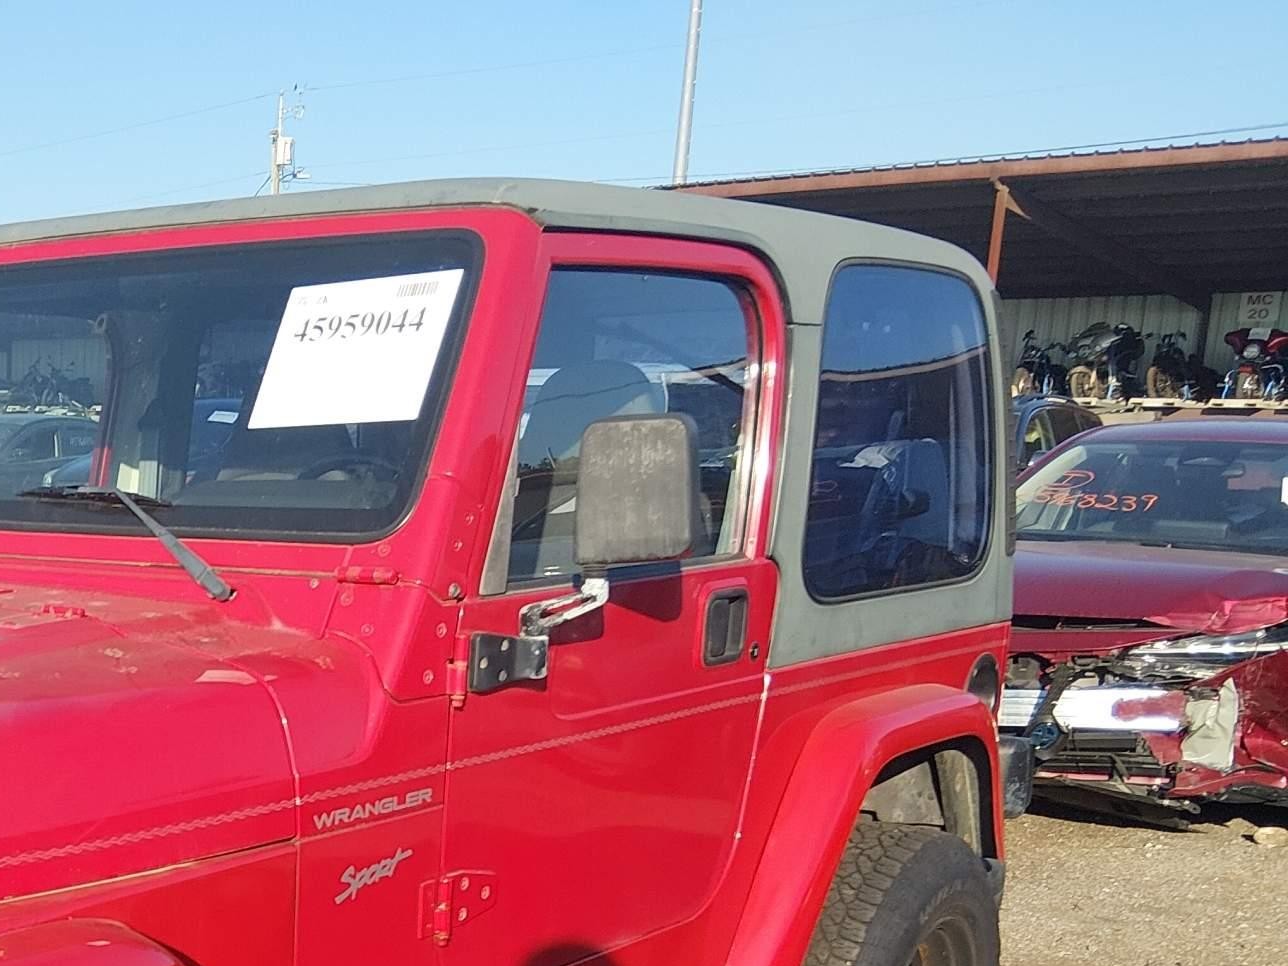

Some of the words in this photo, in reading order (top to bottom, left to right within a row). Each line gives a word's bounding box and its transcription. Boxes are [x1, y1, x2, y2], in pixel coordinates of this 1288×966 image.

[1247, 294, 1274, 305] MC
[294, 307, 427, 342] 45959044
[1247, 308, 1270, 320] 20
[313, 788, 433, 829] WRANGLER
